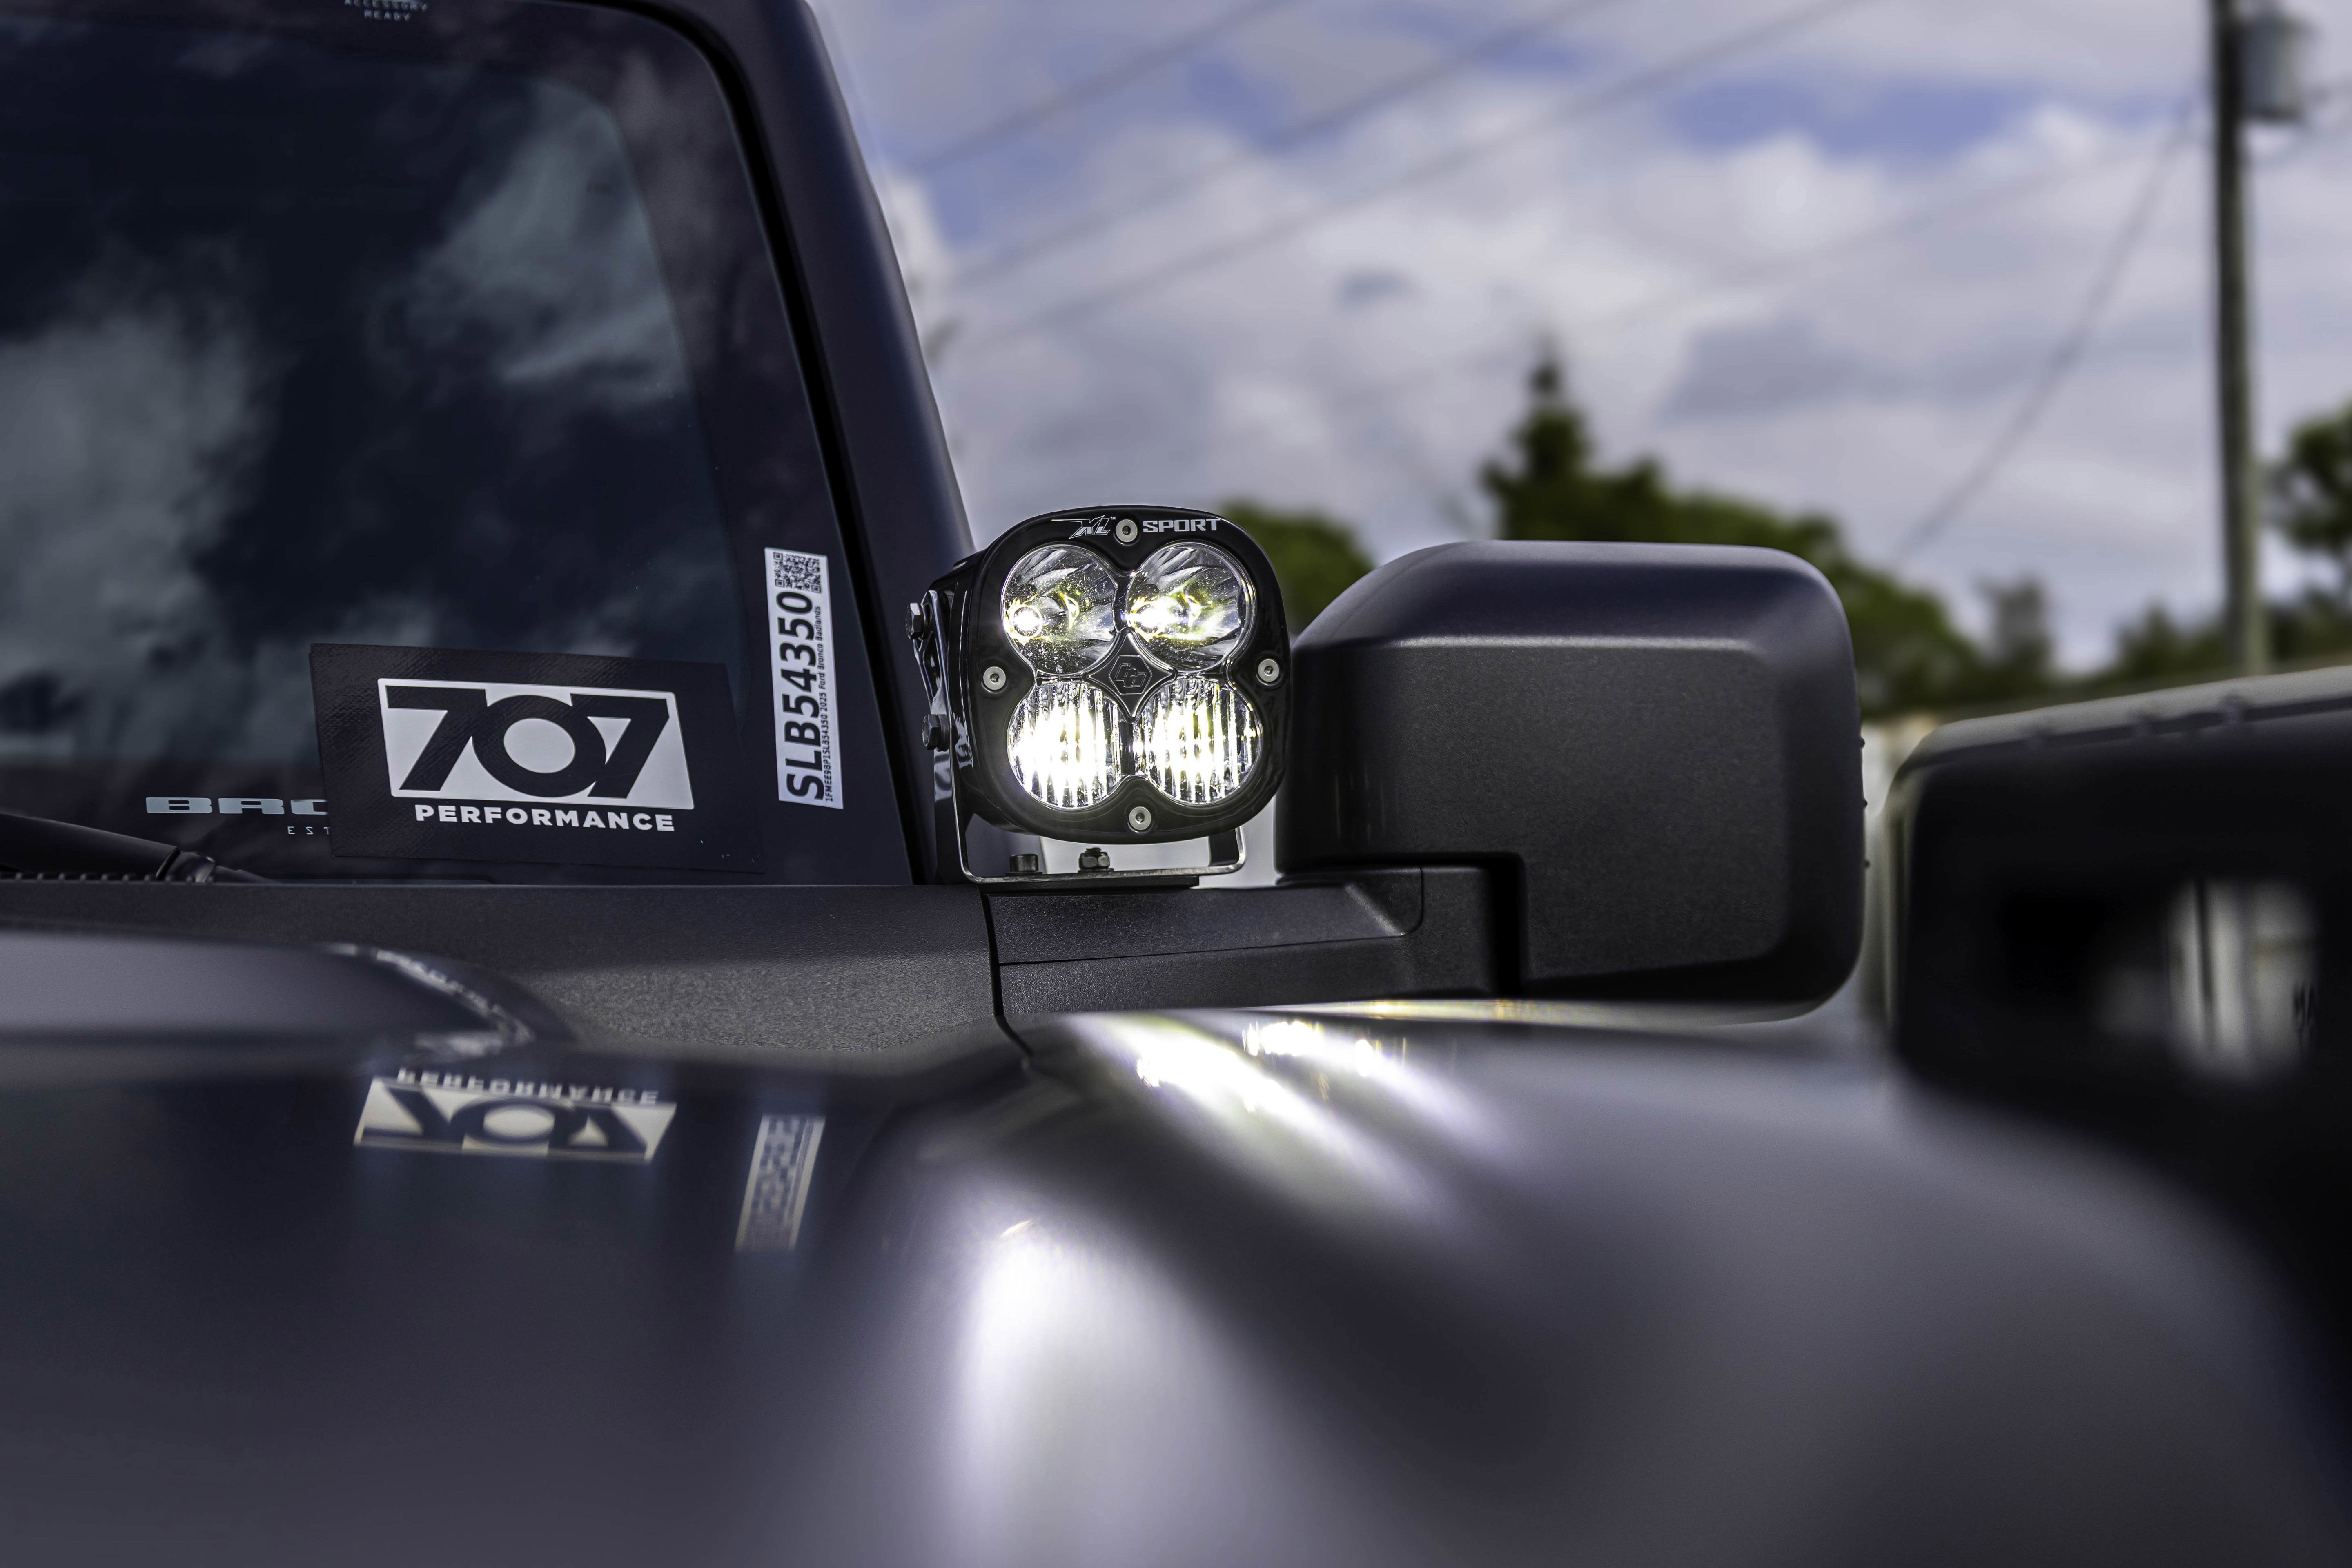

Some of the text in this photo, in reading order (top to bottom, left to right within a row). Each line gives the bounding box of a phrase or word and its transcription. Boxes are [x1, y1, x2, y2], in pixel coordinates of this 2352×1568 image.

[364, 9, 411, 21] READY
[1143, 519, 1221, 532] SPORT
[814, 606, 822, 641] Badlands
[818, 672, 826, 690] Ford
[775, 591, 824, 800] SLB54350
[819, 693, 827, 712] 2025
[385, 685, 670, 798] 707
[415, 804, 675, 832] PERFORMANCE
